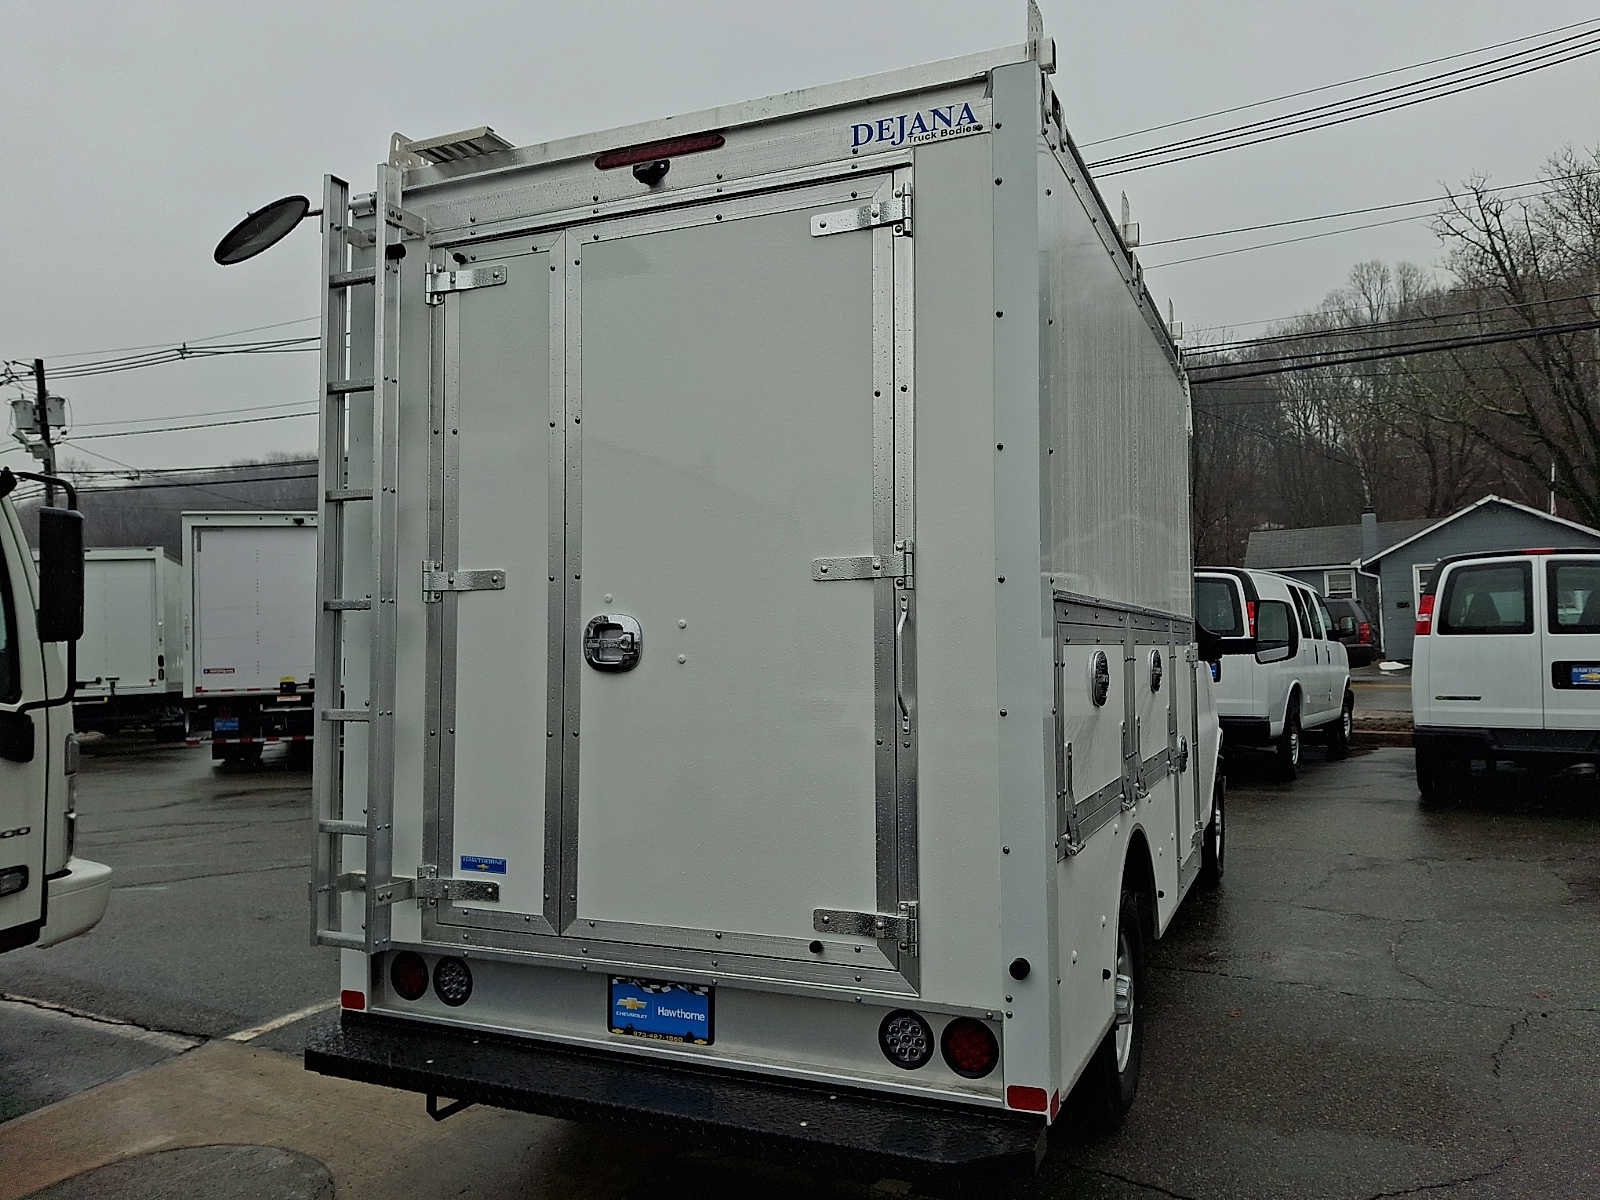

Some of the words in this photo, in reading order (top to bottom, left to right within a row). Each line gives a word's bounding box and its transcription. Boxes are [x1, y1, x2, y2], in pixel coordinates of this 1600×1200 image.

[850, 103, 978, 147] DEJANA
[908, 132, 937, 144] Truck
[657, 1006, 706, 1021] Hawthorne
